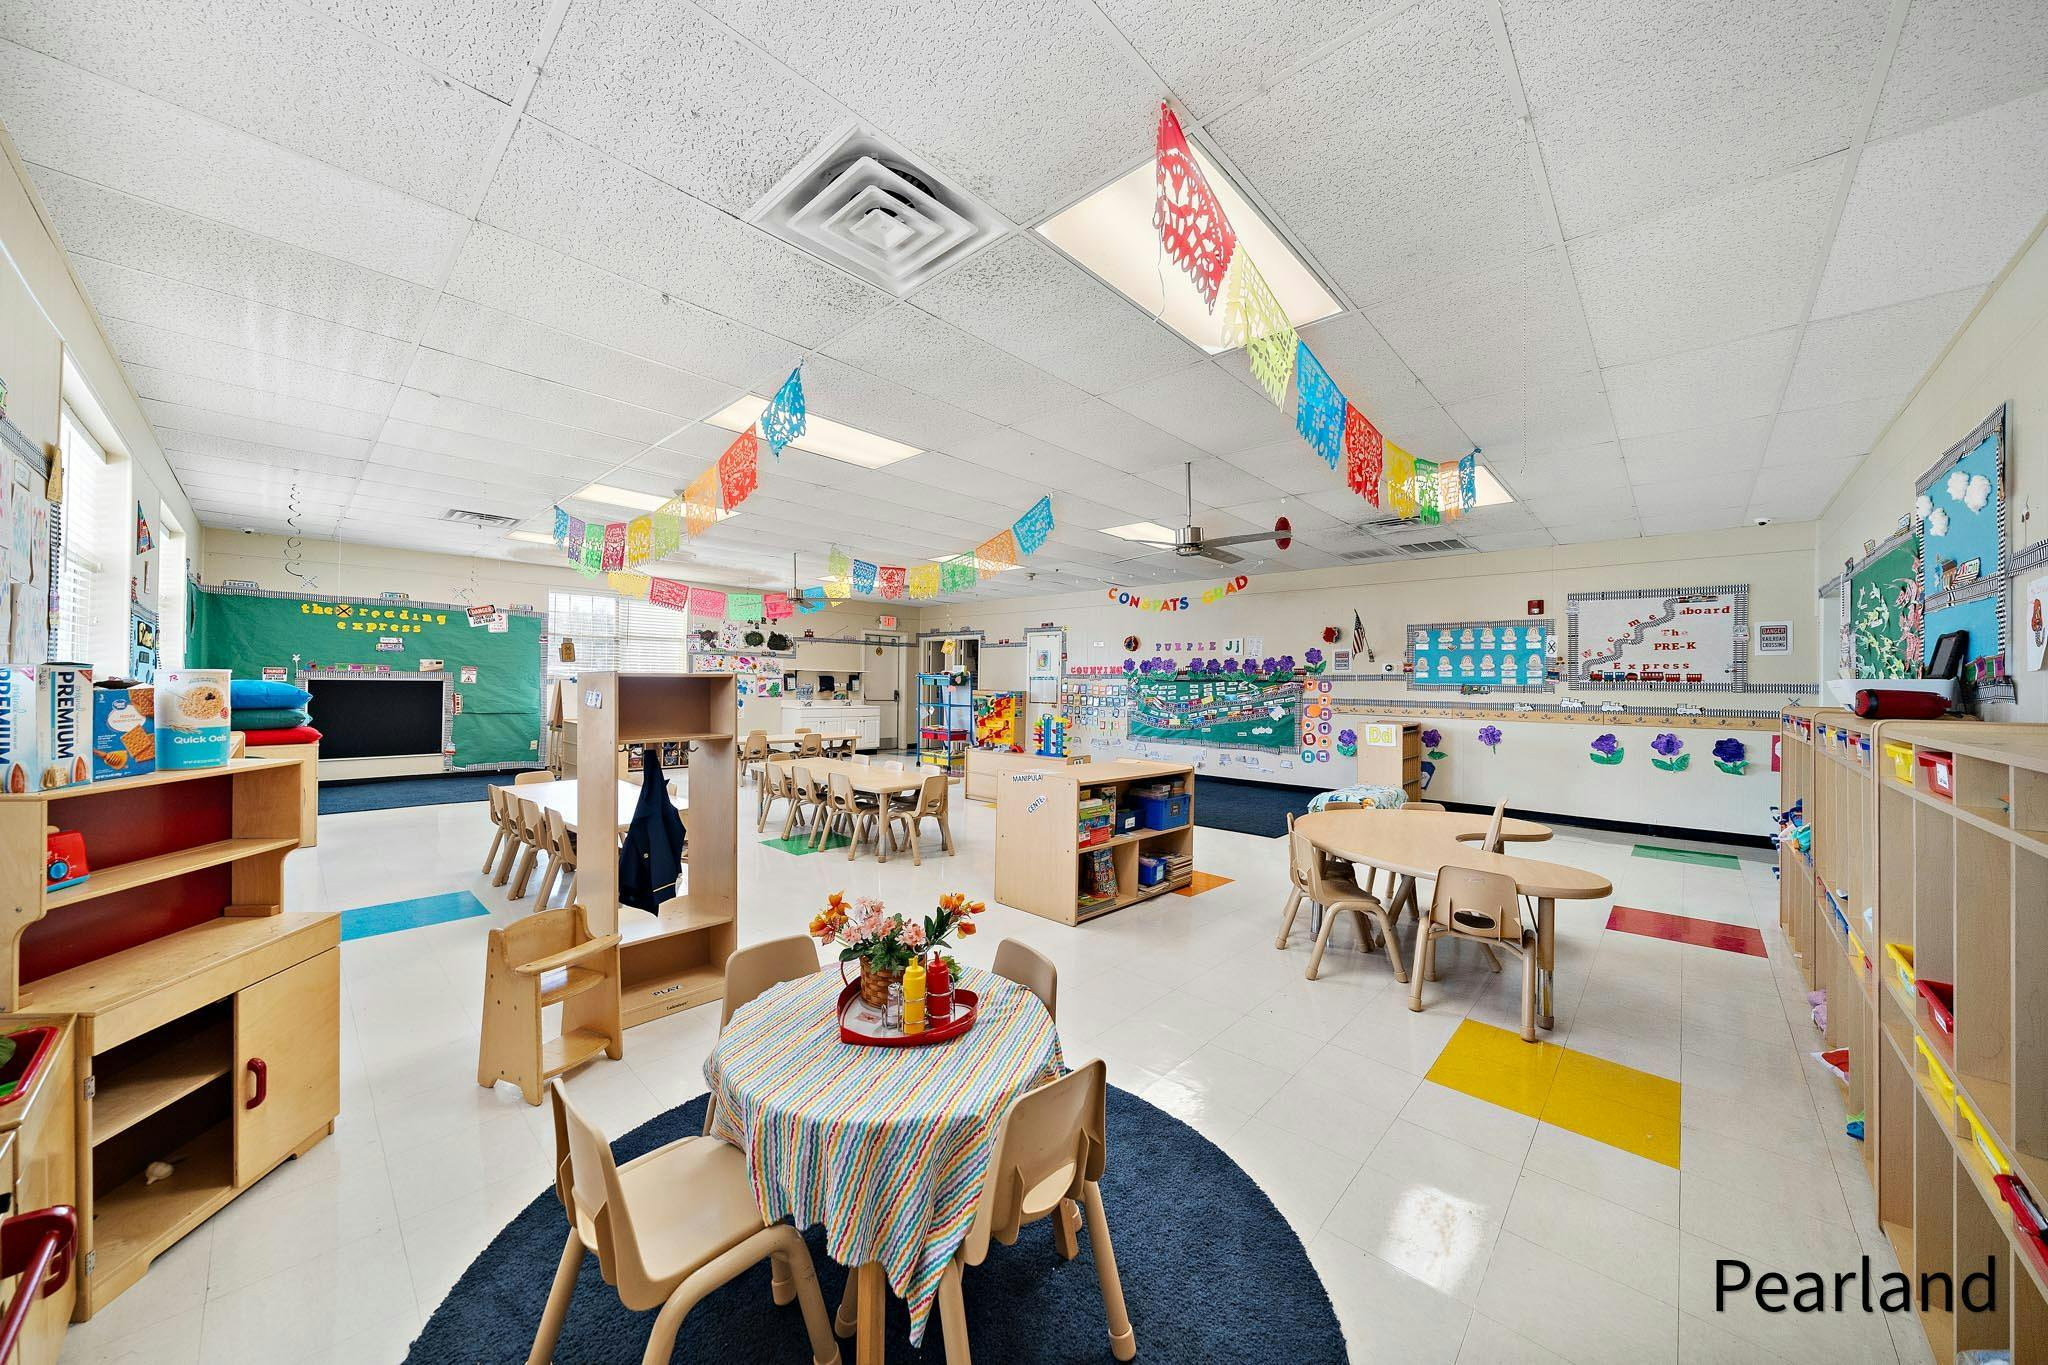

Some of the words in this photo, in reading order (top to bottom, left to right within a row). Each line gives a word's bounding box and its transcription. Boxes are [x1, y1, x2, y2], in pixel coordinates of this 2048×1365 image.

[301, 603, 333, 615] the
[359, 608, 447, 625] reading
[1679, 605, 1731, 615] aboard
[336, 621, 422, 633] express
[1156, 641, 1216, 652] PURPLE
[1654, 641, 1697, 651] PRE-K
[1071, 666, 1123, 675] COUNTING
[1613, 662, 1690, 671] Express
[57, 671, 75, 759] PREMIUM
[174, 735, 207, 744] Quick
[1369, 726, 1393, 743] Dd
[1012, 774, 1043, 782] MANIPULA
